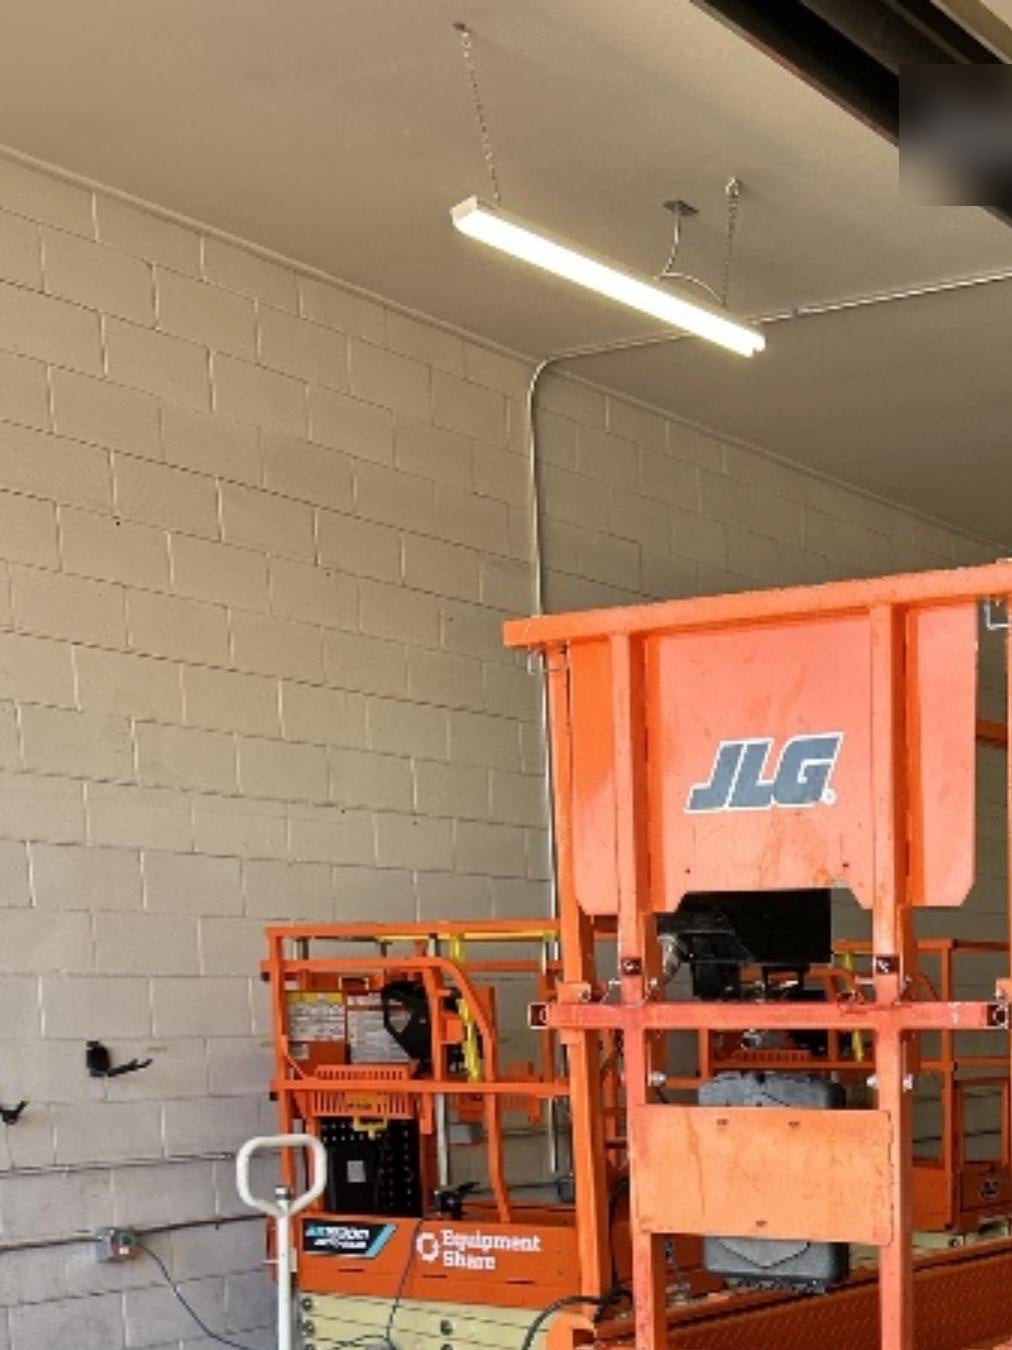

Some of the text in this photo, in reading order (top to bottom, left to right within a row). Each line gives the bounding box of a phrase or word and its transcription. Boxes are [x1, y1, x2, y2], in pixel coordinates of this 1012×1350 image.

[684, 732, 843, 814] JLG
[441, 1228, 541, 1252] Equipment
[442, 1250, 496, 1271] Share
